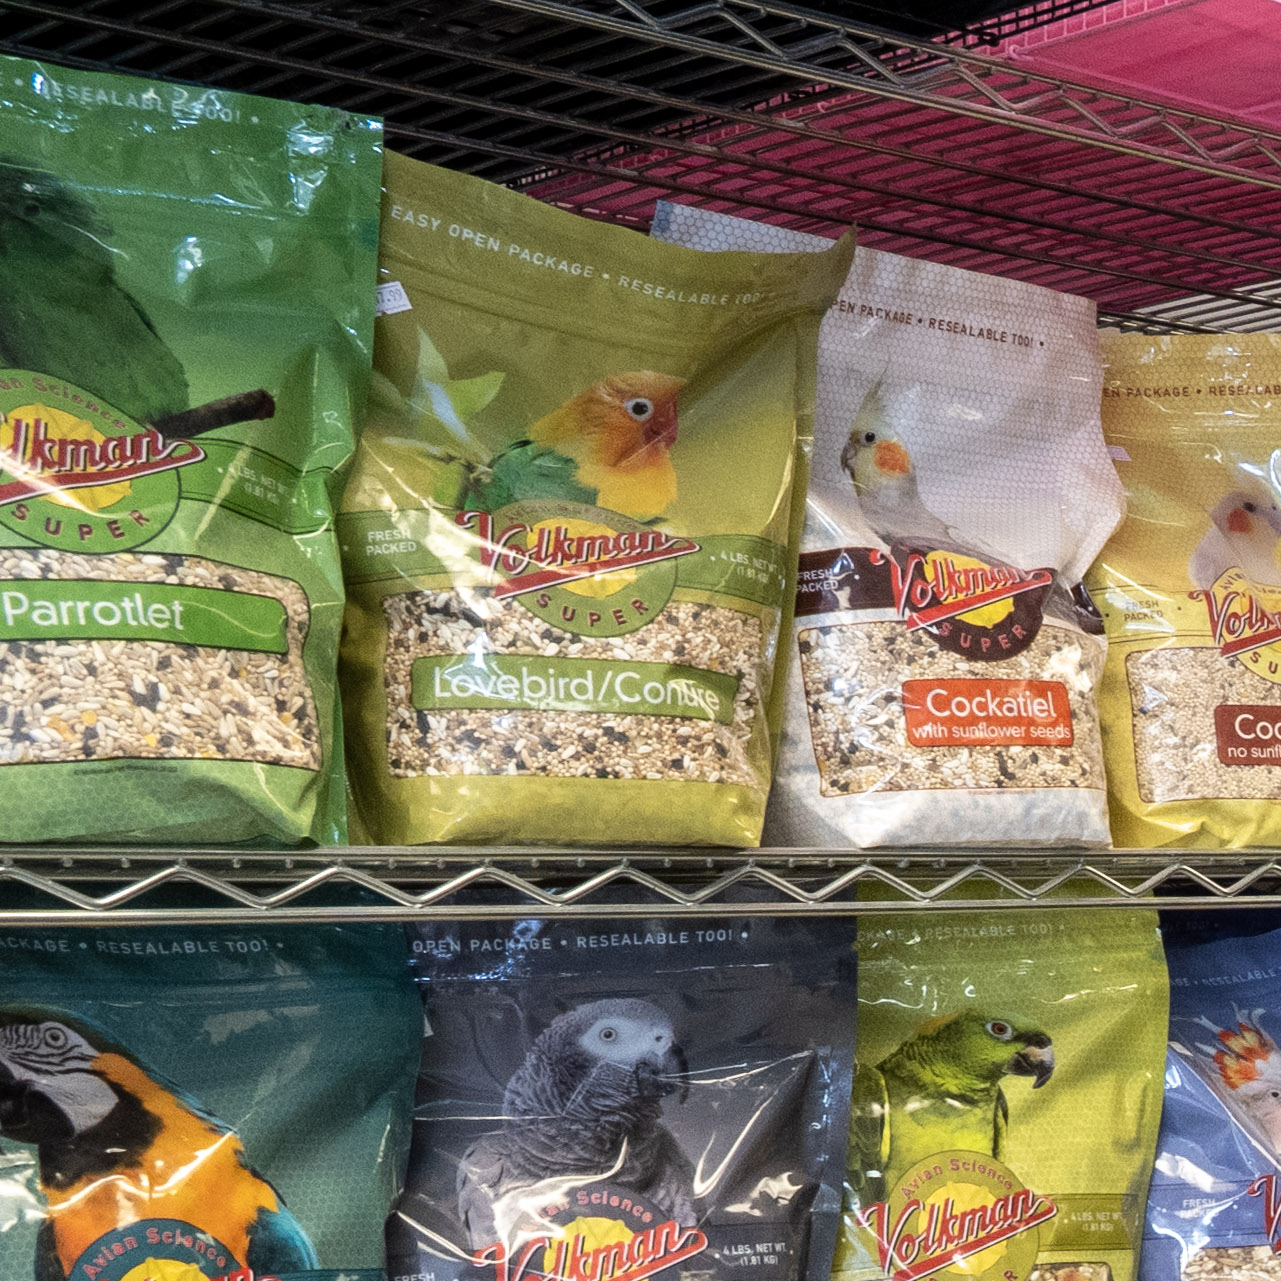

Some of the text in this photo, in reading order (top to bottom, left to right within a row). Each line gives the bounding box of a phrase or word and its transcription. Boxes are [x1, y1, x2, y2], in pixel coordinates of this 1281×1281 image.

[391, 205, 728, 308] EASY OPEN PACKAGE RESEALABLE
[860, 303, 1035, 349] PACKAGE RESEALABLE TOO!
[1126, 386, 1190, 399] PACKAGE
[12, 504, 151, 541] SUPER
[367, 529, 412, 544] FRESH
[366, 541, 417, 557] PACKED
[456, 510, 698, 592] Volkman
[871, 549, 1048, 625] Volkman
[3, 590, 184, 631] Parrotlet
[537, 592, 652, 629] SUPER
[937, 619, 1030, 652] SUPER
[926, 688, 1057, 720] Cockatiel
[912, 722, 1072, 741] with sunflower seeds
[1227, 746, 1247, 760] no
[96, 940, 270, 956] RESEALABLE TOO!
[470, 928, 734, 954] PACKAGE RESEALABLE TOO!
[901, 1158, 1015, 1200] Avian Science
[577, 1189, 654, 1225] Science
[83, 1227, 228, 1279] Avian Science
